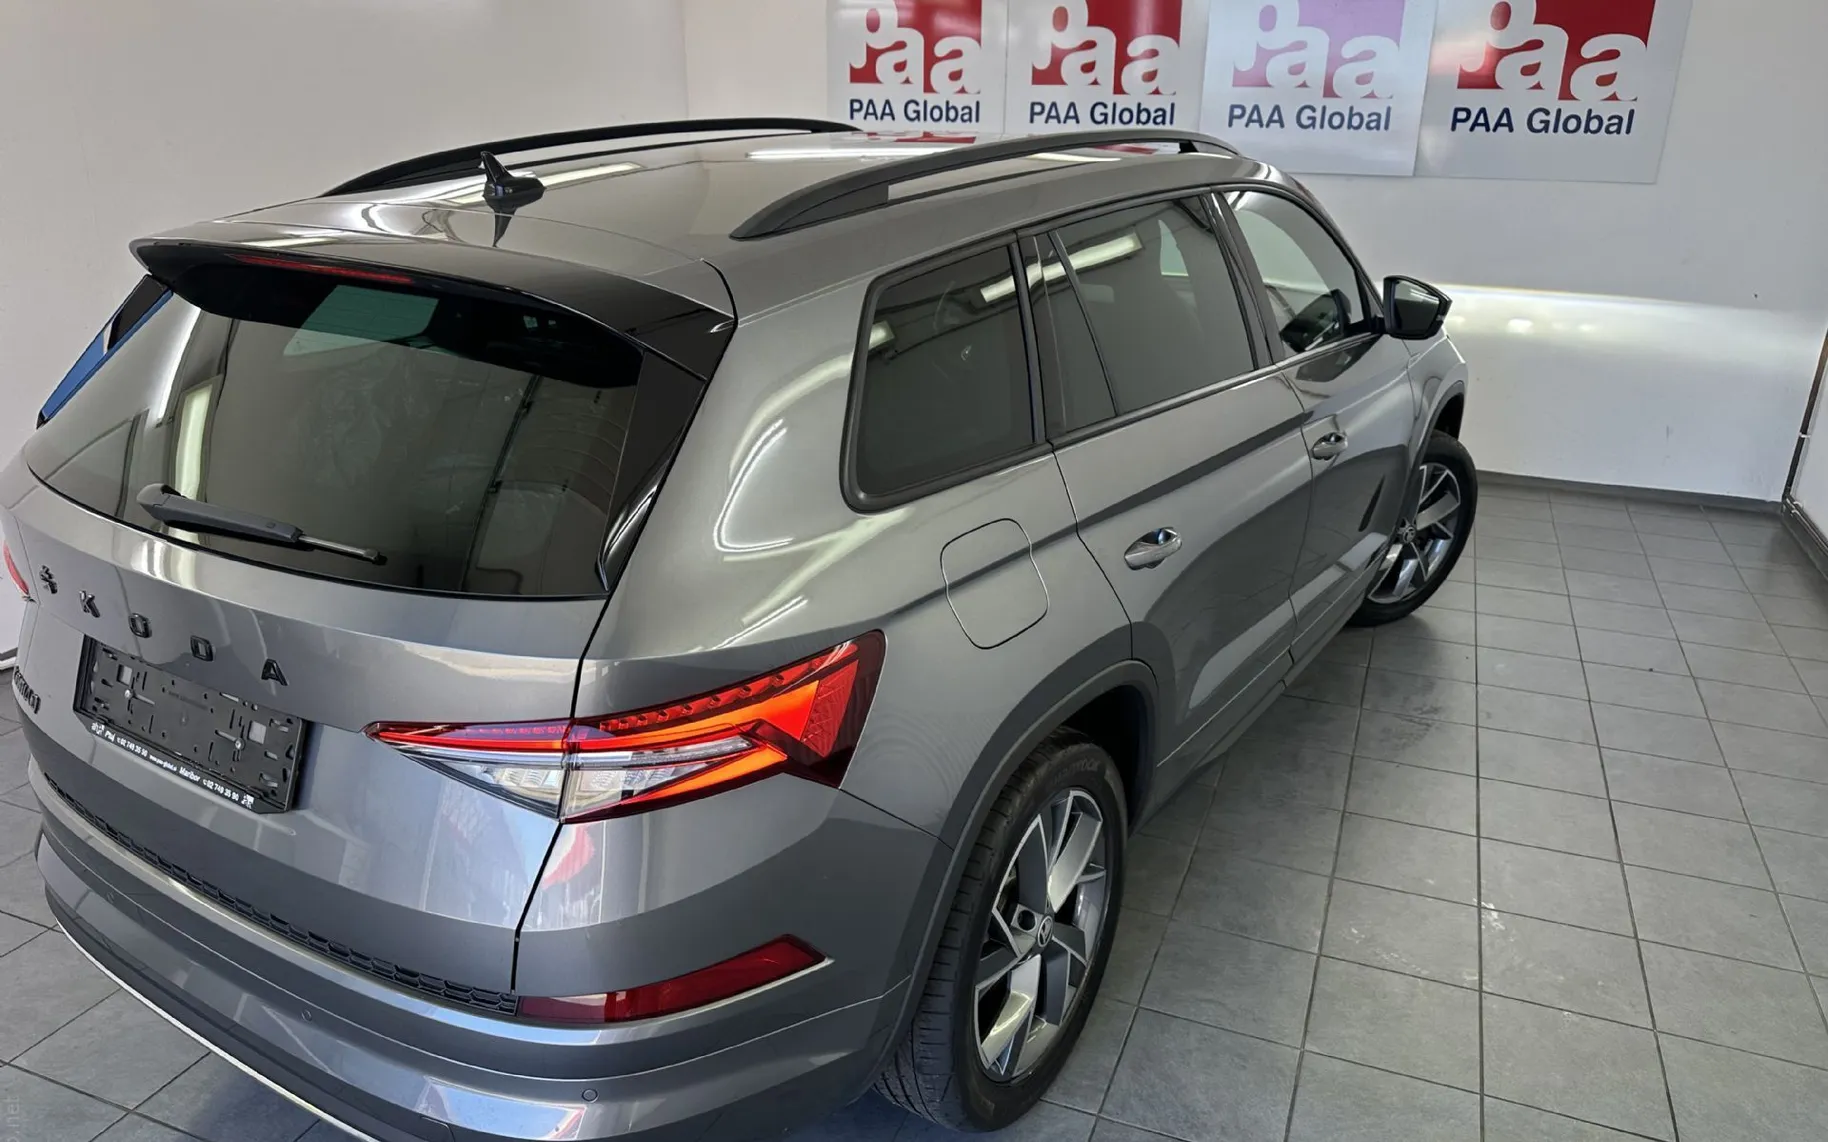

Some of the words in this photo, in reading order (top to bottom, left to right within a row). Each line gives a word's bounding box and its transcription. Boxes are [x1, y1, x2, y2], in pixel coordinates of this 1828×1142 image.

[850, 98, 895, 122] PAA
[903, 100, 980, 123] Global
[1029, 101, 1081, 125] PAA
[1089, 102, 1175, 126] Global
[1227, 104, 1285, 129] PAA
[1295, 104, 1392, 132] Global
[1450, 106, 1514, 134] PAA
[1526, 107, 1635, 136] Global
